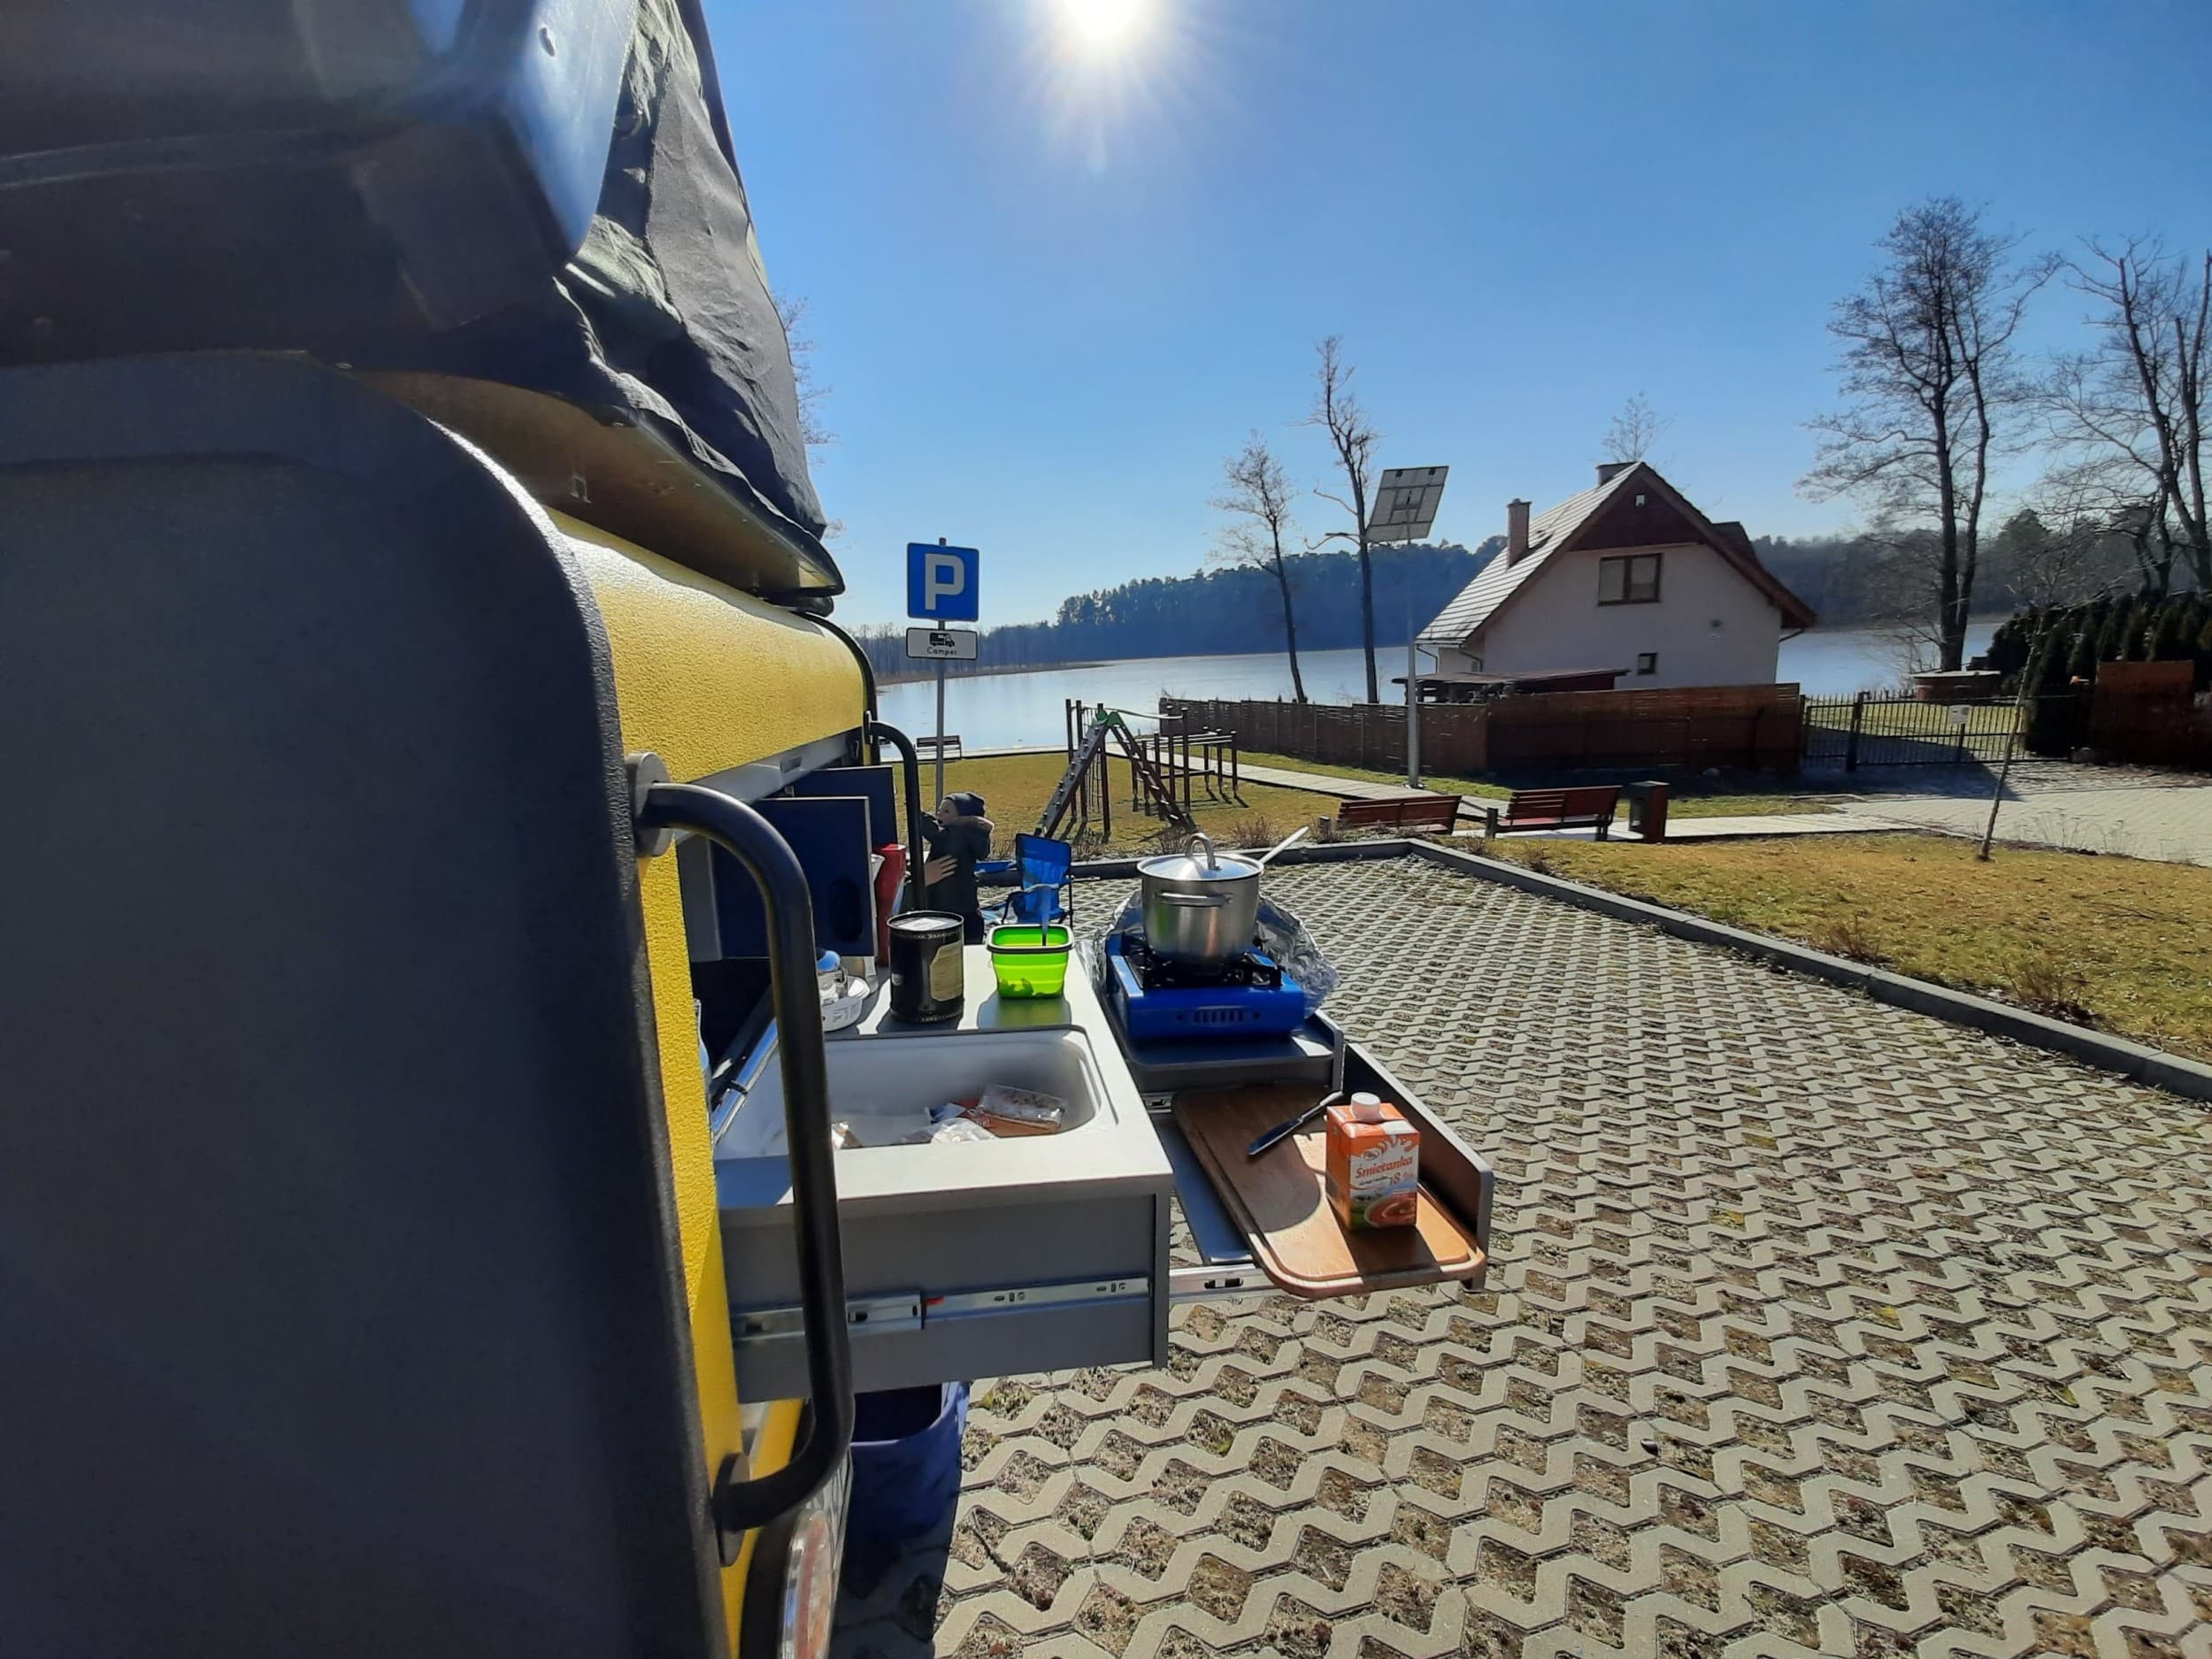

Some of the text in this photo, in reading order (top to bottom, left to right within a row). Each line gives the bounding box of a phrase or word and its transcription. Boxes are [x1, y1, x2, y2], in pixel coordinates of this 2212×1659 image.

[925, 553, 964, 611] P
[927, 647, 957, 656] Camper
[1356, 1156, 1413, 1179] Śmietanka
